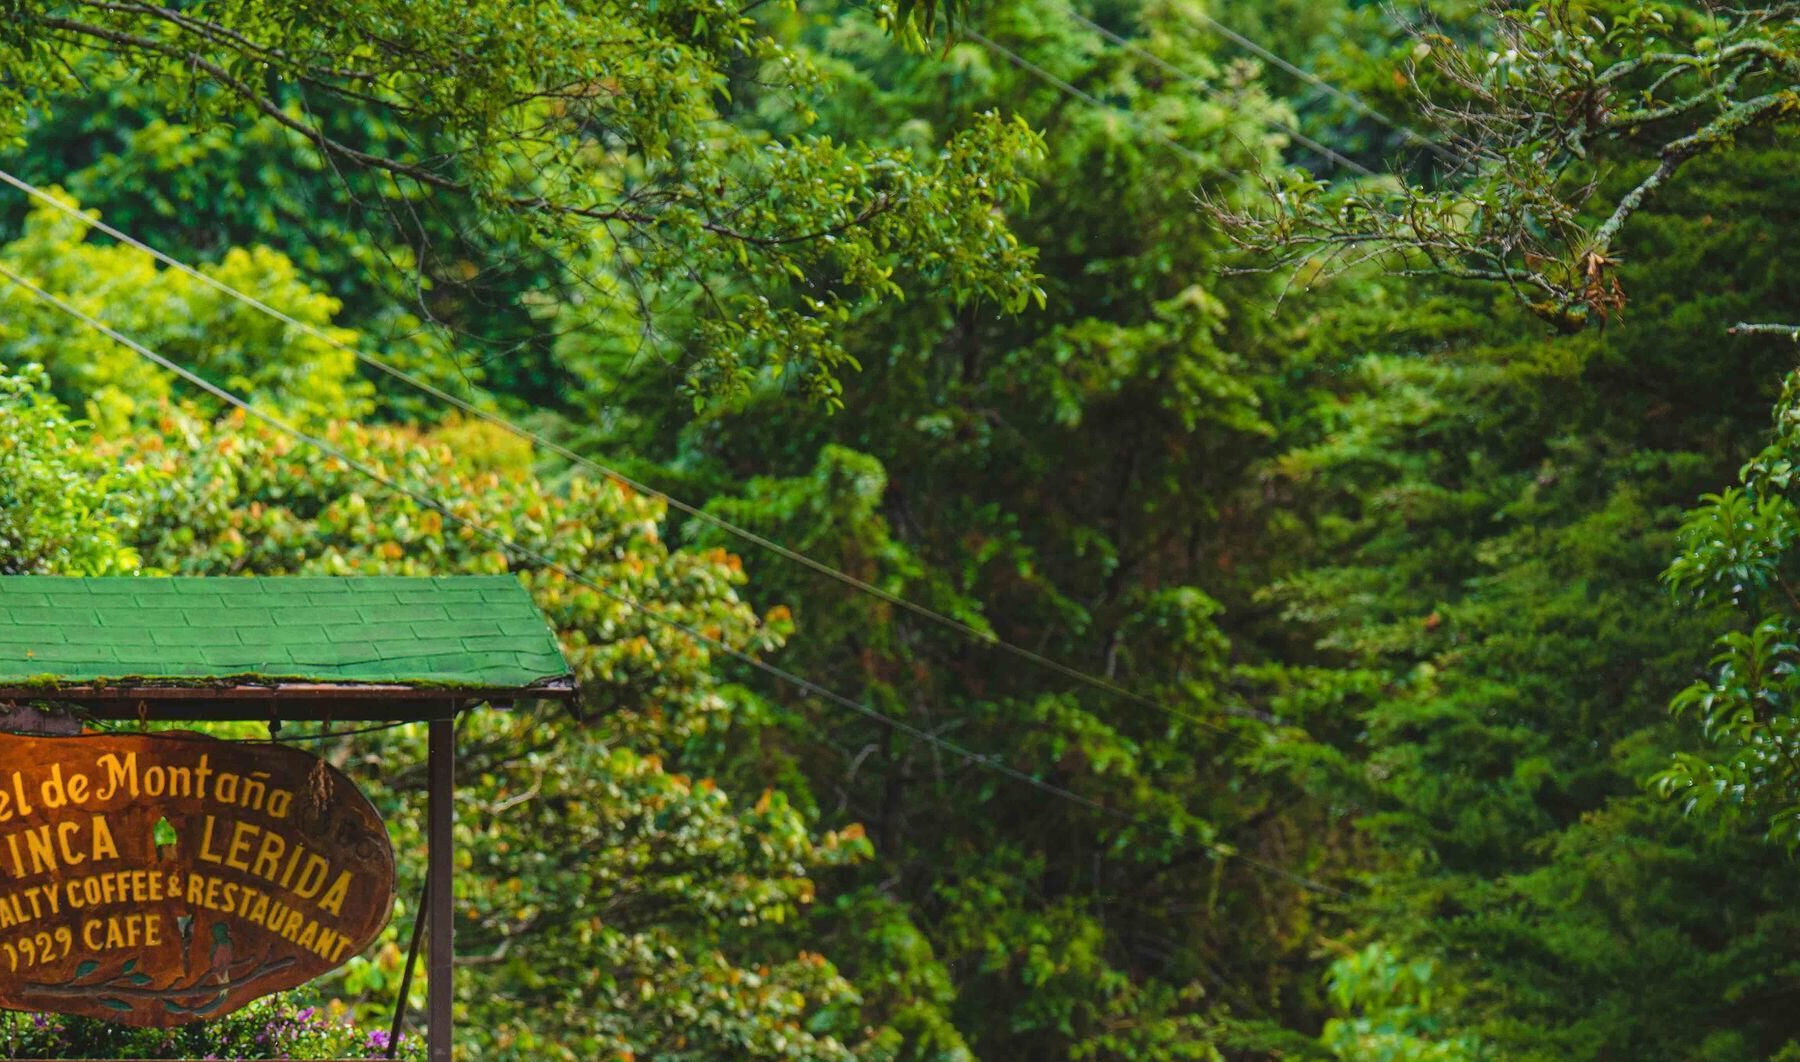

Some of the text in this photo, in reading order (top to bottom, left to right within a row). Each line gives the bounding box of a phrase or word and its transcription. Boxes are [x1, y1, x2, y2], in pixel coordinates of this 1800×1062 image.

[40, 762, 90, 809] de
[96, 751, 293, 818] Montaña
[199, 814, 355, 917] LERIDA
[3, 914, 162, 973] 1929 CAFE
[66, 870, 163, 909] COFFEE
[167, 875, 182, 898] &
[186, 872, 352, 964] RESTAURANT
